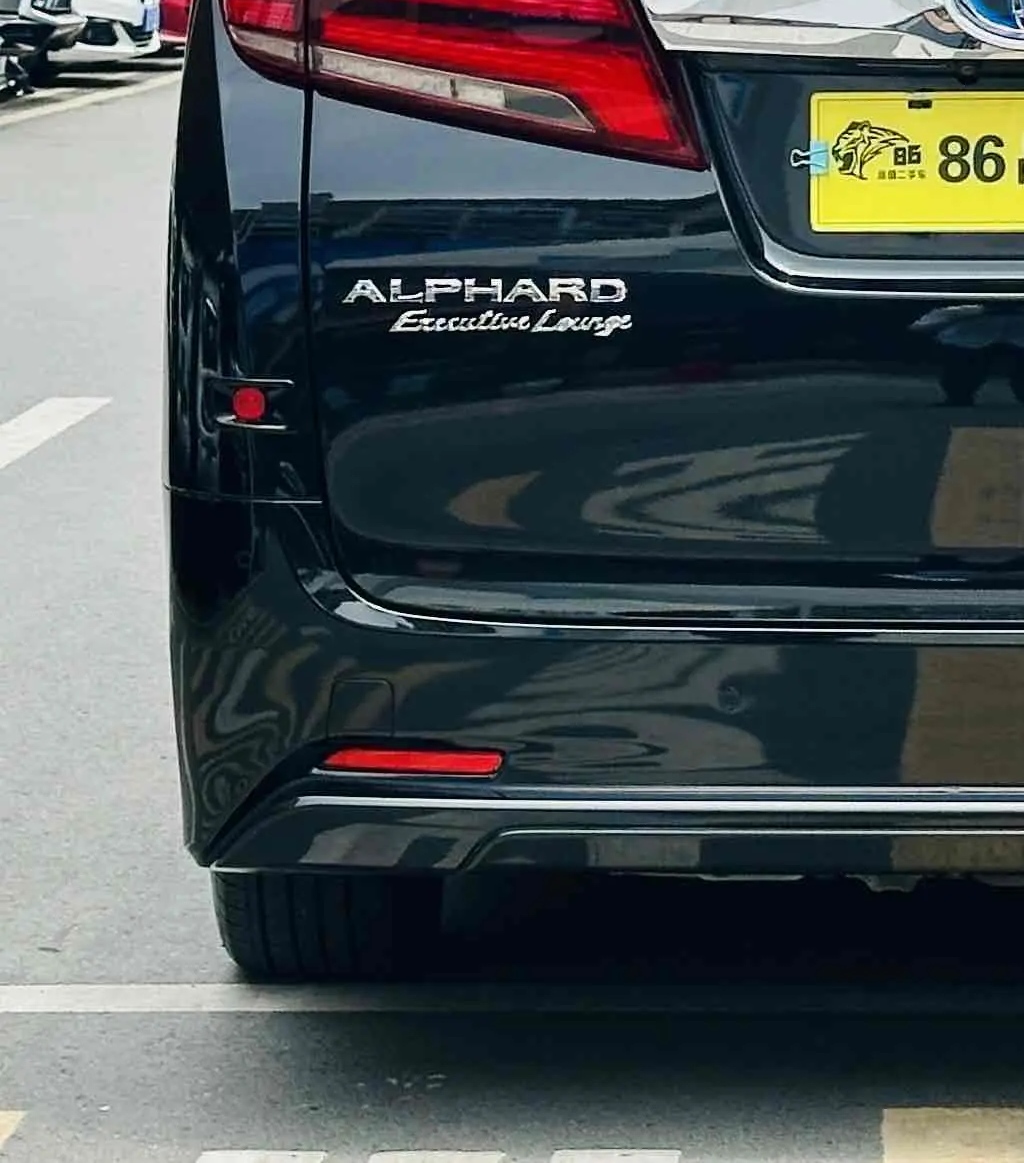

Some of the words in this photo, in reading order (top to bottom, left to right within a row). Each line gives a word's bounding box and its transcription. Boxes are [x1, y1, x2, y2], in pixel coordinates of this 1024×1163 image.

[893, 144, 922, 166] 86
[341, 277, 629, 304] ALPHARD
[388, 308, 531, 333] Executive
[530, 308, 633, 337] Lounge
